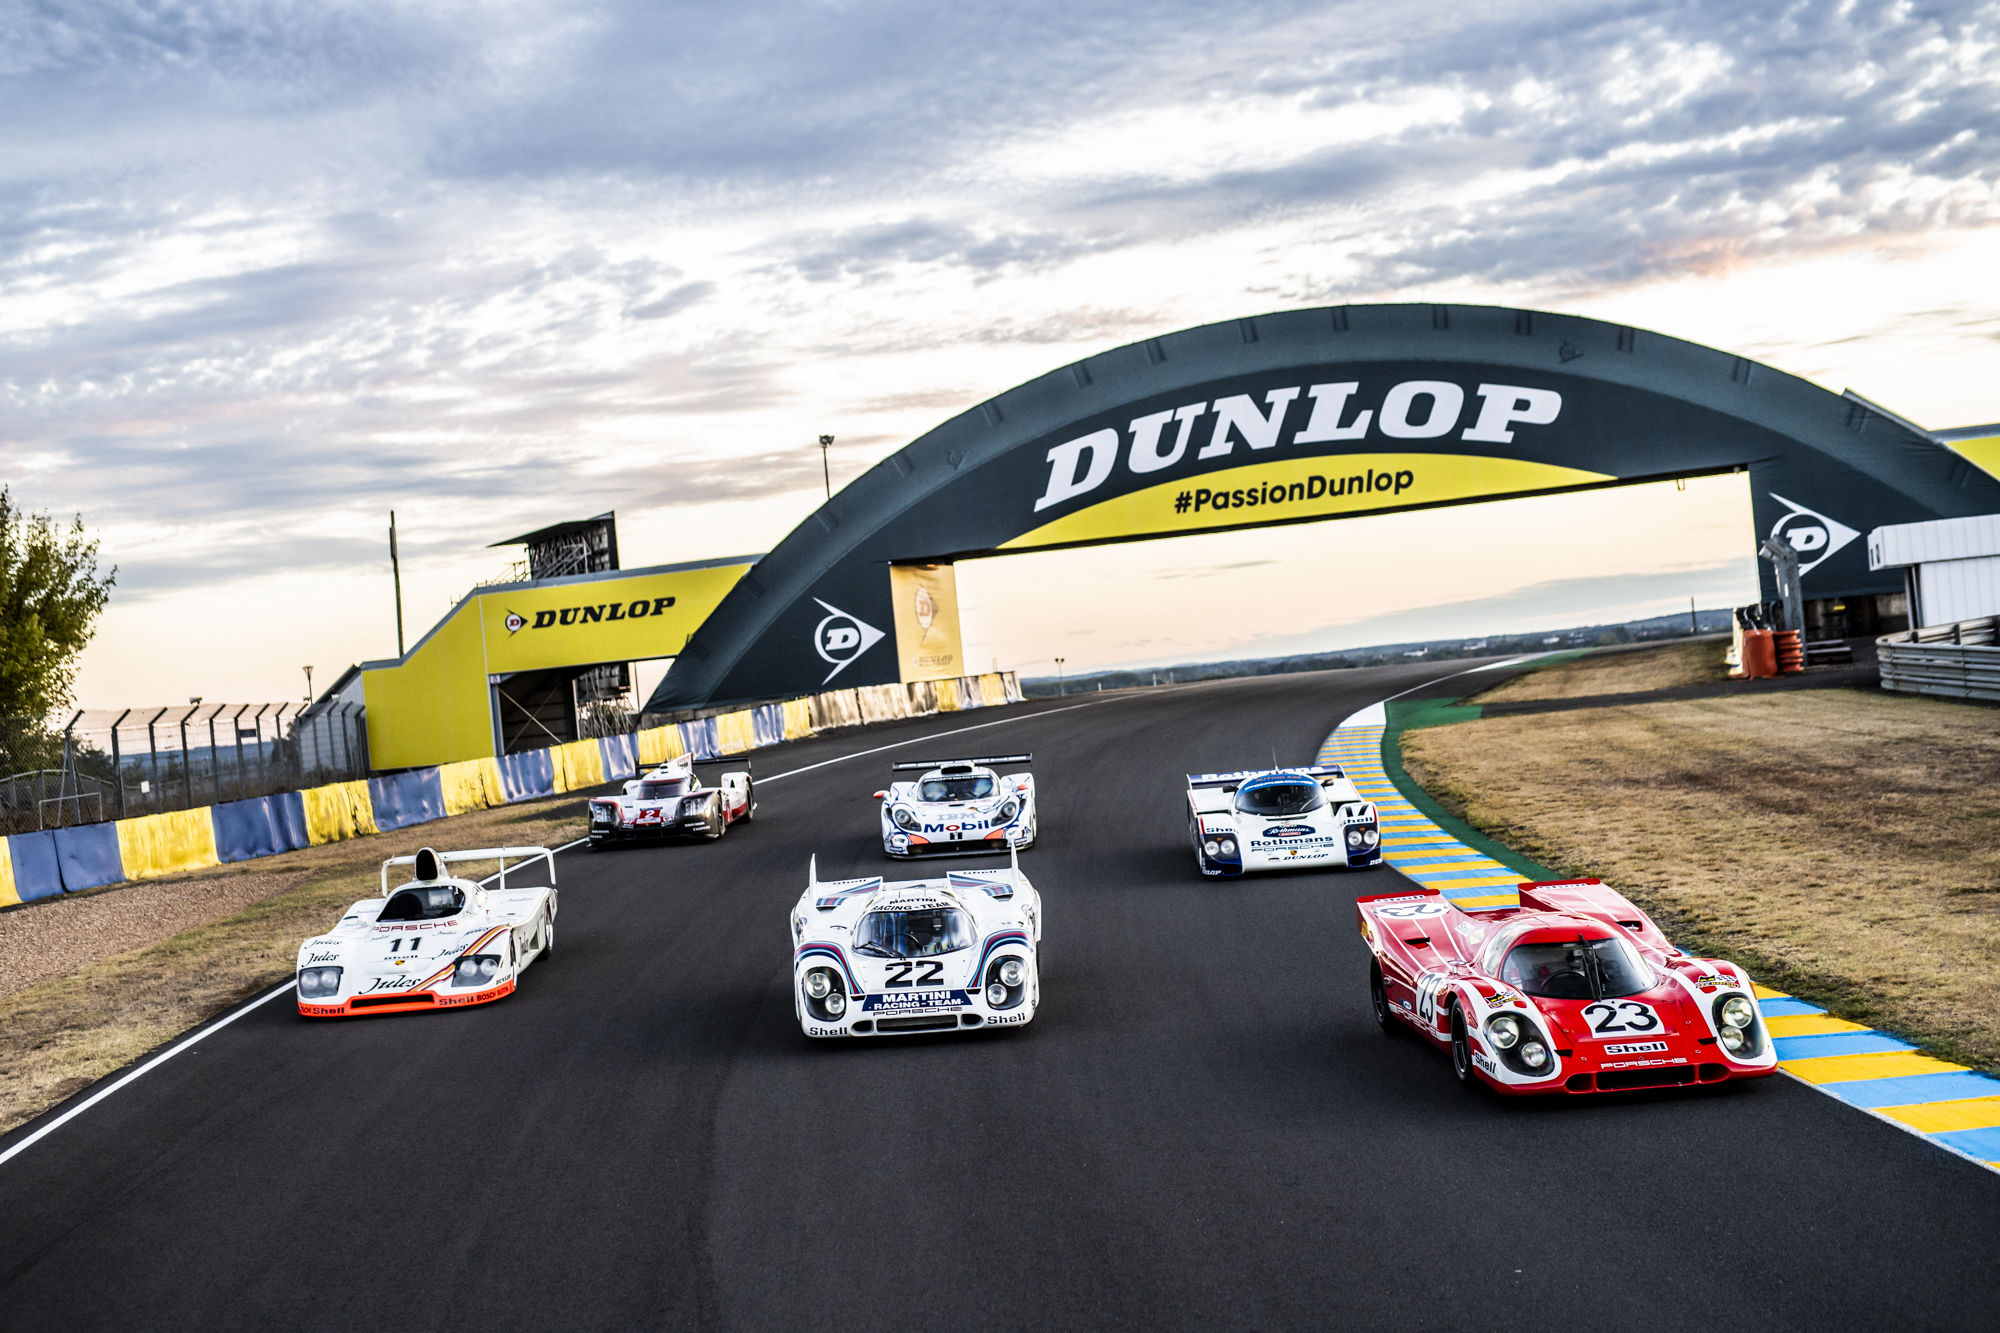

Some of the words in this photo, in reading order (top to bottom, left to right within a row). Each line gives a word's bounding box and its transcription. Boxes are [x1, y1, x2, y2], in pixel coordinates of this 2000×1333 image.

[1034, 380, 1562, 512] DUNLOP
[1174, 469, 1414, 514] #PassionDunlop
[1786, 526, 1828, 552] D
[532, 597, 676, 629] DUNLOP
[825, 627, 860, 651] D
[645, 810, 655, 819] 2
[924, 820, 989, 833] Mobil
[1268, 827, 1311, 835] Rothmans
[1250, 836, 1333, 847] Rothmans
[1251, 843, 1334, 852] PORSCHE
[889, 897, 937, 905] MARTINI
[372, 920, 459, 933] PORSCHE
[391, 937, 422, 952] 11
[431, 943, 469, 960] Jules
[301, 951, 340, 967] Jules
[885, 961, 944, 988] 22
[358, 974, 421, 995] Jules
[439, 996, 474, 1005] Shell
[882, 991, 951, 1003] MARTINI
[1419, 974, 1442, 1024] 23
[873, 1006, 962, 1016] PORSCHE
[988, 1012, 1025, 1024] Shell
[1585, 1003, 1658, 1033] 23
[810, 1027, 847, 1036] Shell
[1606, 1042, 1666, 1054] Shell
[1475, 1052, 1497, 1074] Shell
[1600, 1058, 1688, 1069] PORSCHE
